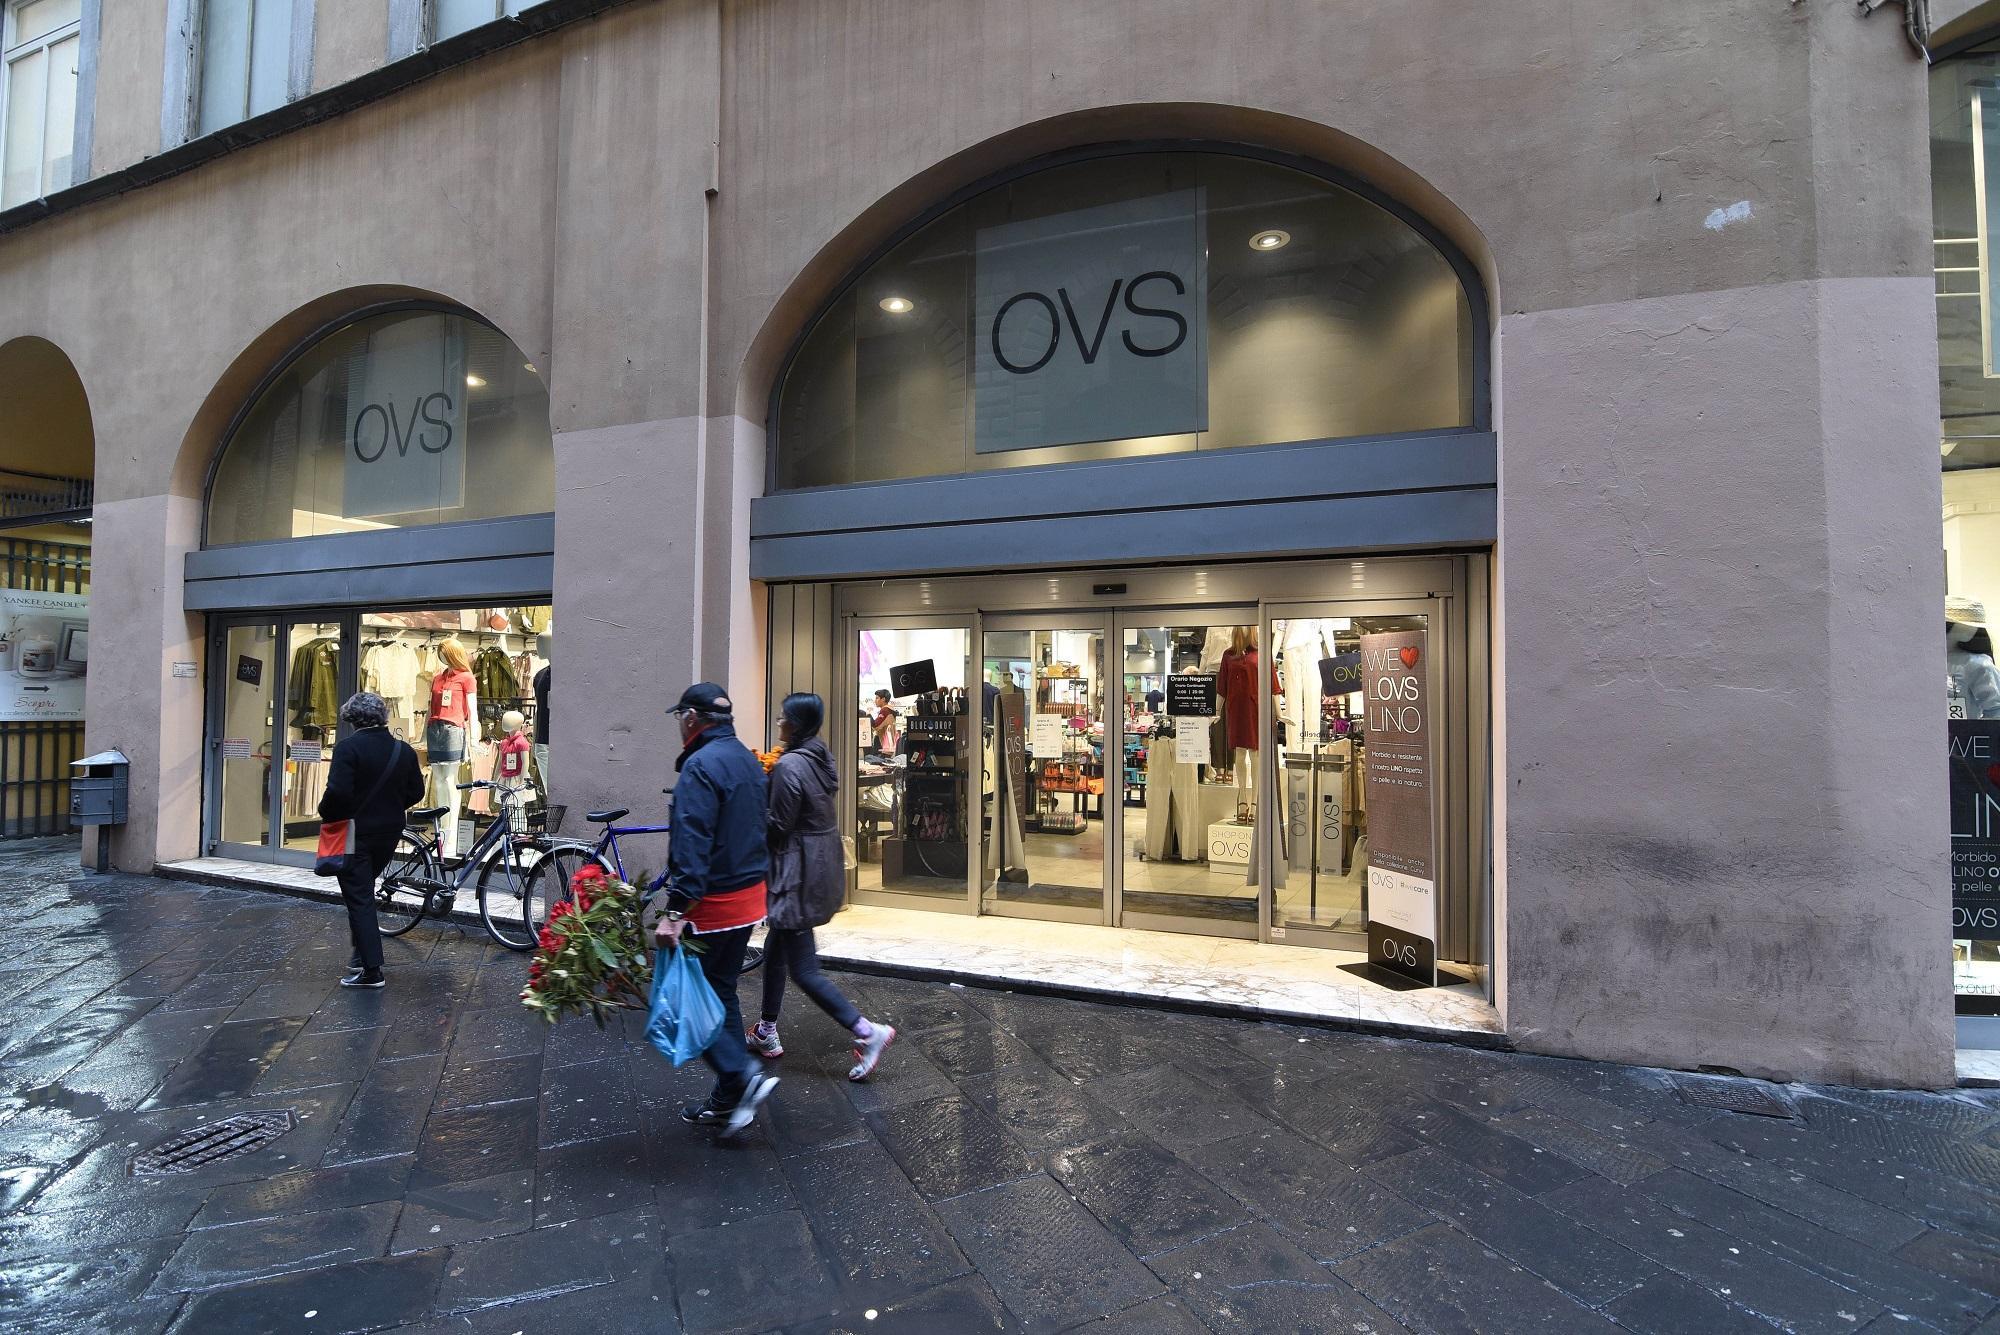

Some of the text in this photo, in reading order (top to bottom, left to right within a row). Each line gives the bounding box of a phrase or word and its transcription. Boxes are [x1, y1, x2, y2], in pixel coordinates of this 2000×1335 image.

[991, 270, 1188, 375] OVS
[353, 392, 453, 463] OVS
[3, 596, 42, 606] YANKEE
[43, 599, 80, 608] CANDLE
[1364, 647, 1400, 672] WE
[1368, 676, 1420, 701] LOVS
[1369, 706, 1421, 734] LINO
[1950, 705, 1963, 719] 29
[910, 720, 928, 730] BLUE
[1371, 751, 1391, 759] Morbido
[1397, 753, 1423, 761] resistente
[1390, 764, 1403, 772] LINO
[1323, 804, 1340, 840] OVS
[1211, 829, 1237, 838] SHOP
[1211, 840, 1249, 859] OVS
[1373, 850, 1425, 867] Disponibile anche
[1410, 866, 1425, 876] Curvy
[1953, 866, 2000, 878] LINO O
[1371, 871, 1394, 889] OVS
[1962, 881, 1992, 893] pelle
[1952, 906, 1998, 929] OVS
[1382, 938, 1417, 967] OVS
